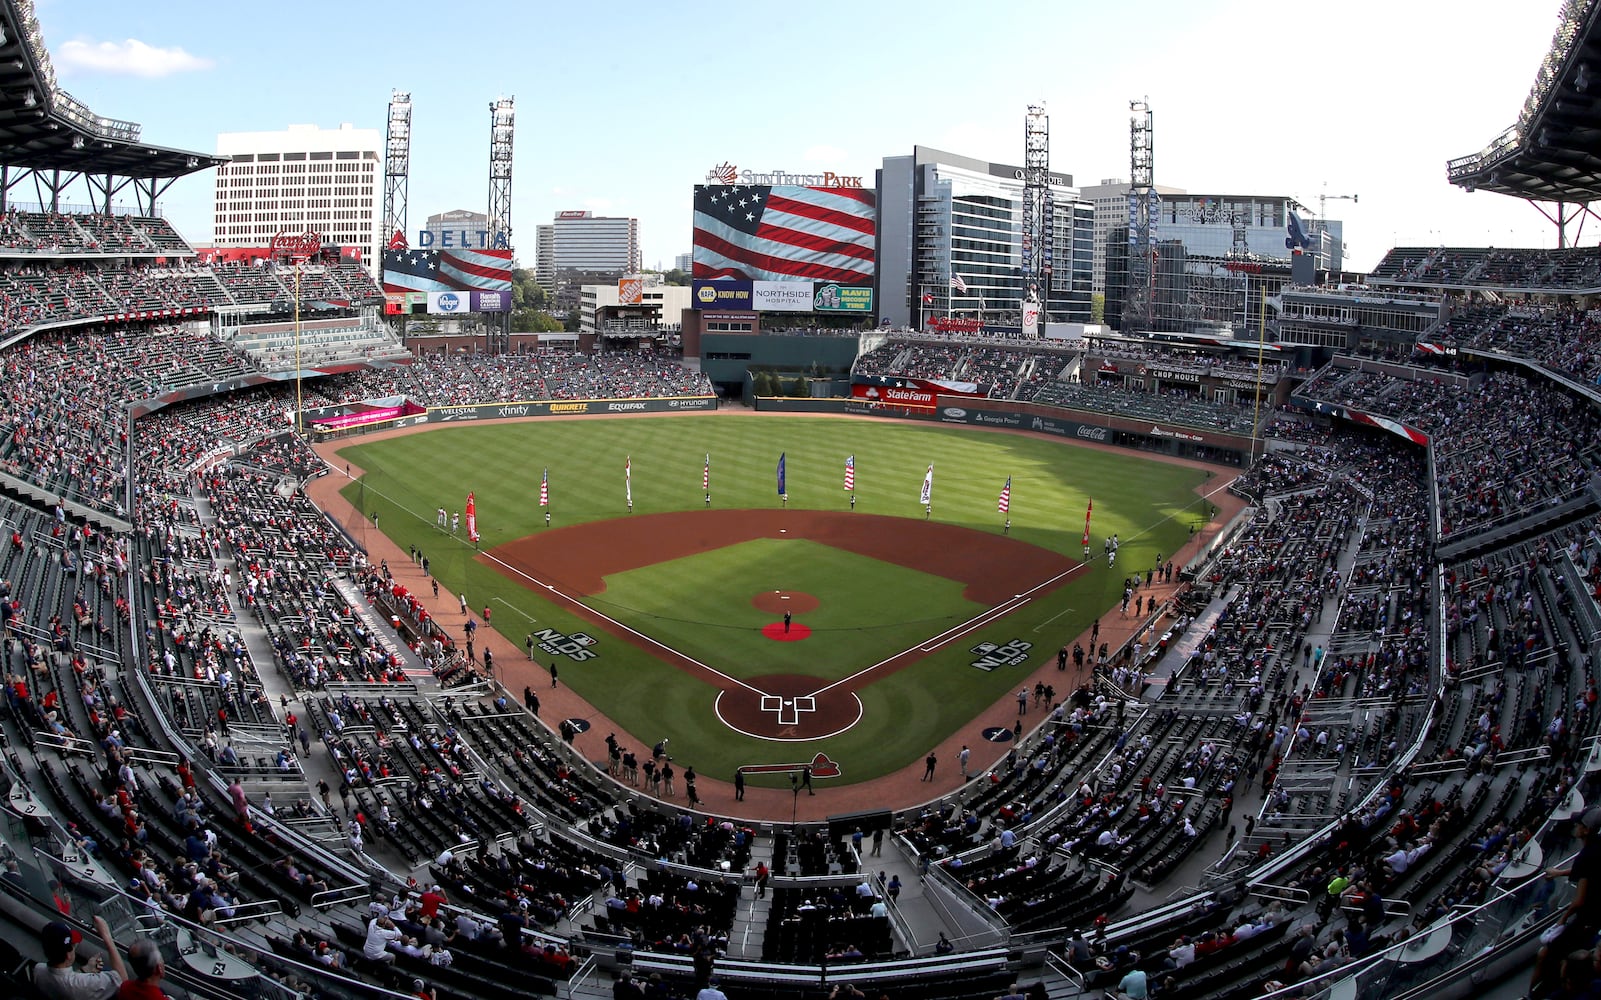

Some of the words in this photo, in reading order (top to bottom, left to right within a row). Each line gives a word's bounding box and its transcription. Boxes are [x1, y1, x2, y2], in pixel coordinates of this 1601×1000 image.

[1177, 208, 1234, 219] COMCAST
[419, 230, 510, 248] DELTA
[701, 290, 715, 298] NAPA
[717, 290, 735, 299] KNOW
[736, 290, 749, 299] HOW
[439, 296, 459, 310] Kroger
[1153, 370, 1173, 379] CHOP
[1175, 373, 1199, 382] HOUSE
[498, 405, 528, 417] xfinity
[550, 403, 588, 411] QUIKRETE
[608, 403, 647, 411] EQUIFAX
[984, 416, 1003, 424] Georgia
[533, 628, 597, 661] NLDS
[538, 642, 560, 655] 2019
[971, 639, 1033, 671] NLDS
[1007, 653, 1028, 666] 2019
